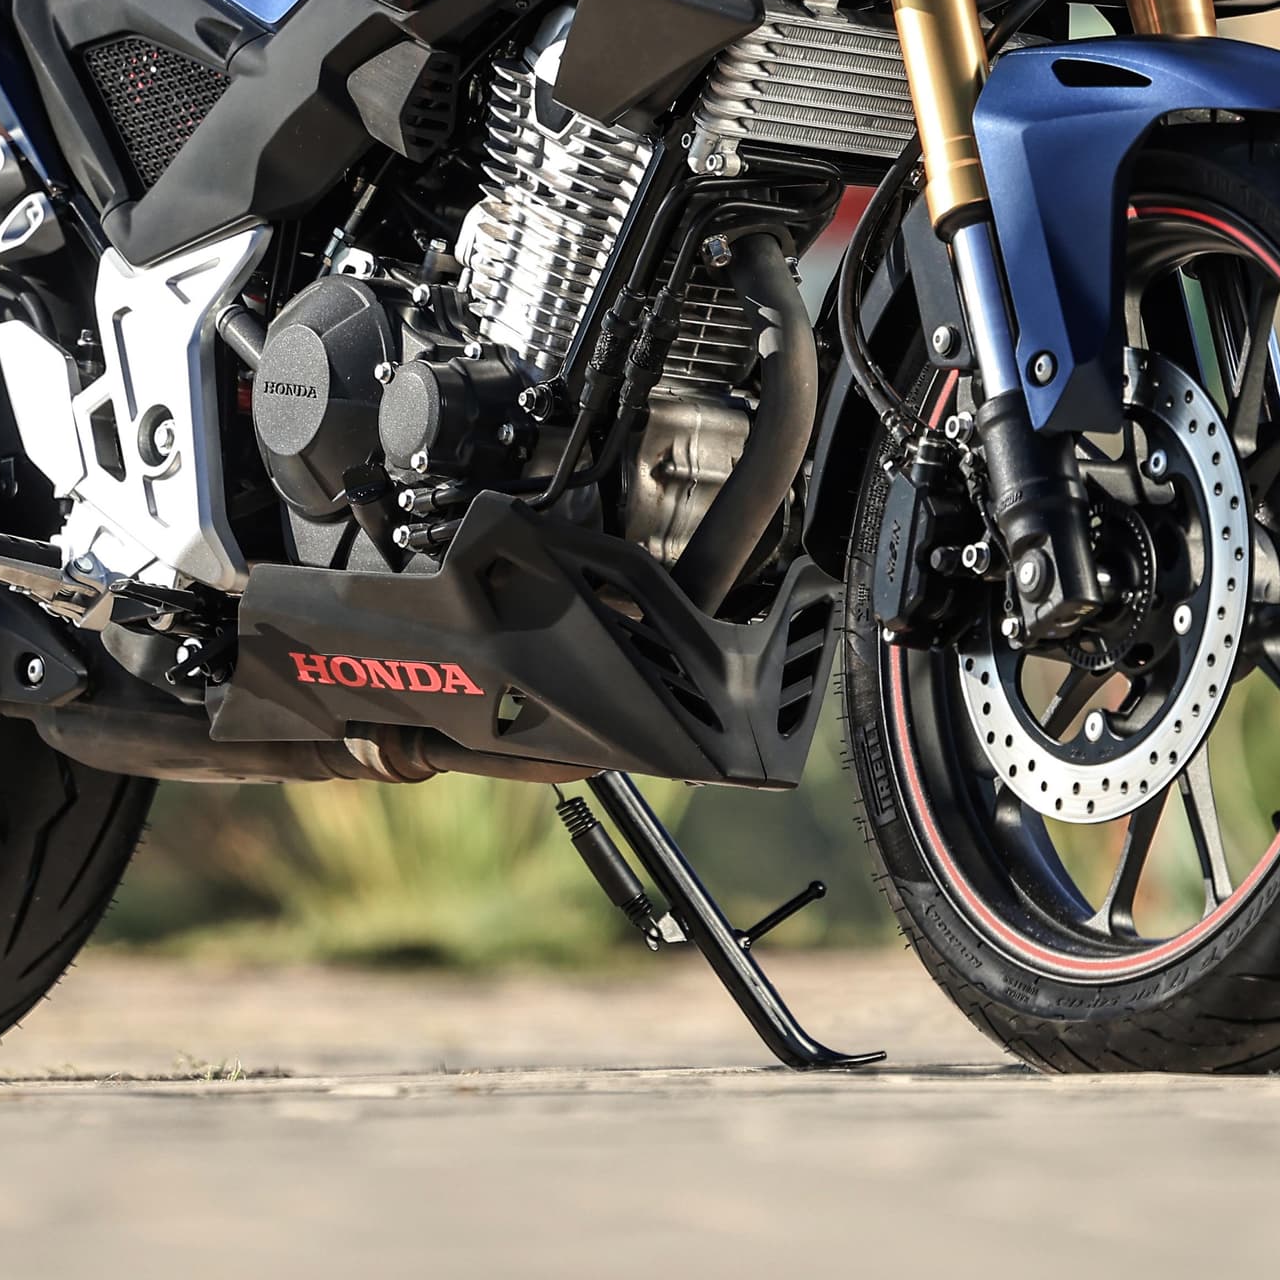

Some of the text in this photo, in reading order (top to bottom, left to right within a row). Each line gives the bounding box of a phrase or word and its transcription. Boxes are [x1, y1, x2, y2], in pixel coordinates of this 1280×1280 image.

[263, 381, 318, 399] HONDA
[288, 652, 485, 695] HONDA
[862, 720, 898, 828] PIRELLI
